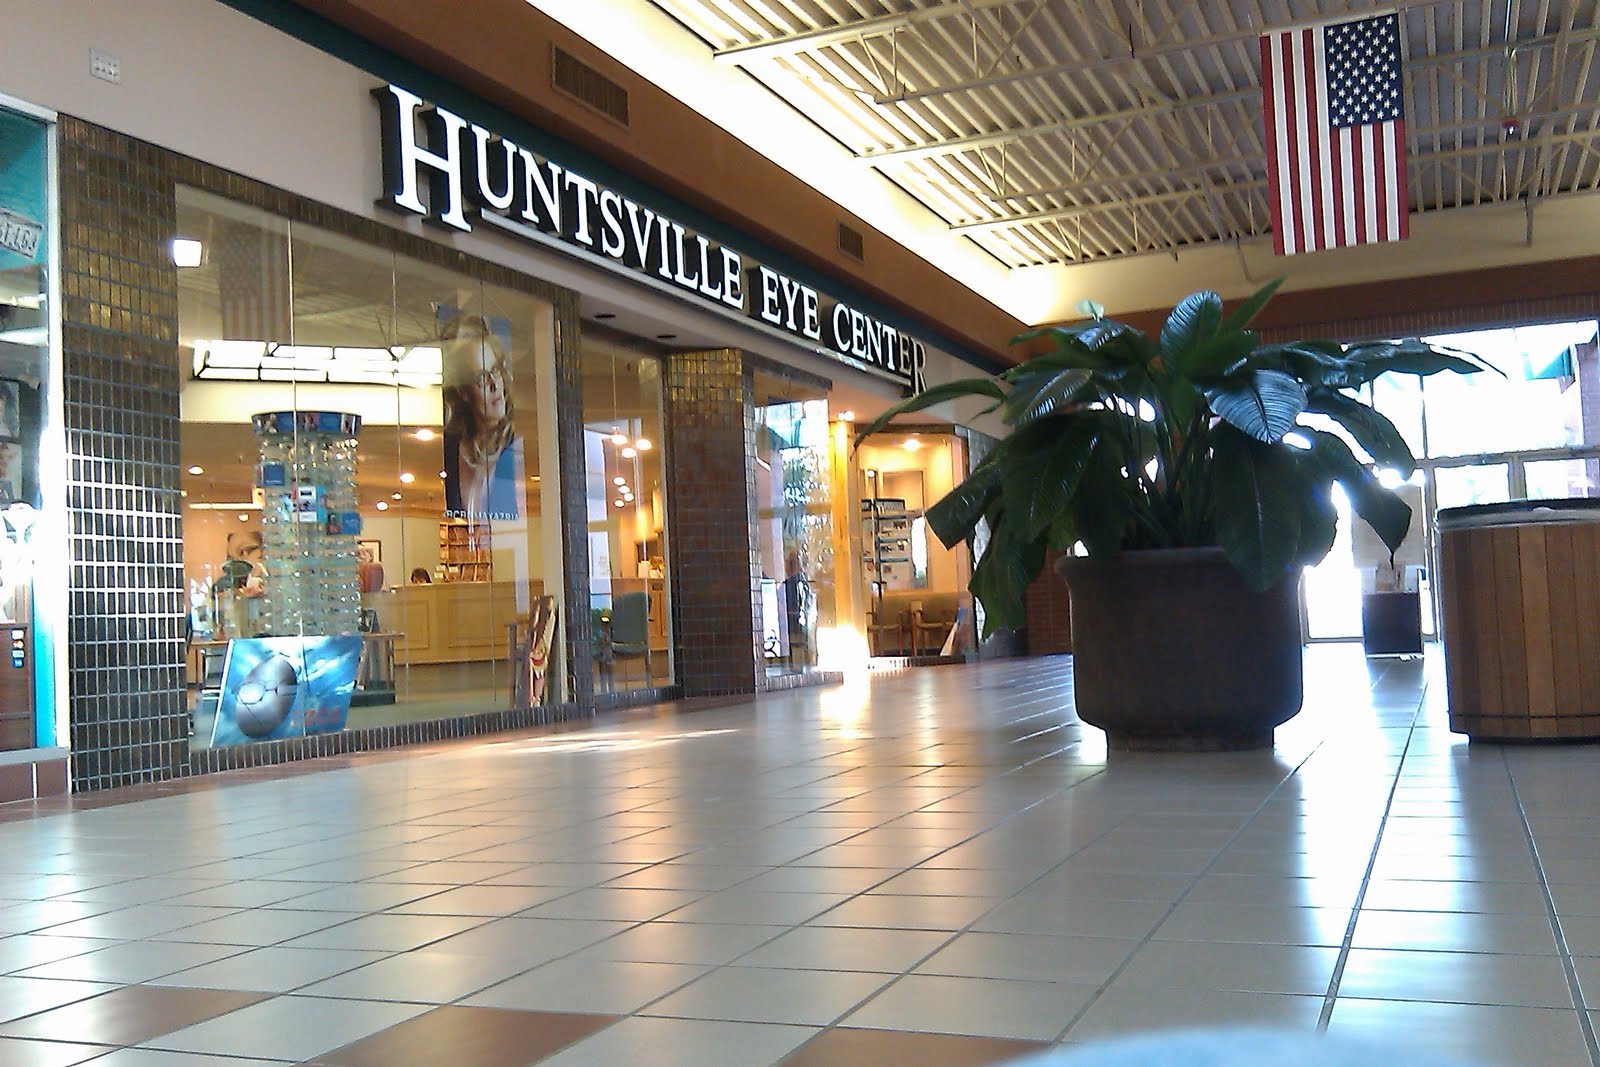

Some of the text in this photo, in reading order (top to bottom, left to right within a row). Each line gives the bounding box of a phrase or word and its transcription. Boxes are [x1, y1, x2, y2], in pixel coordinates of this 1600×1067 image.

[386, 84, 927, 397] HUNTSVILLE EYE CENTER
